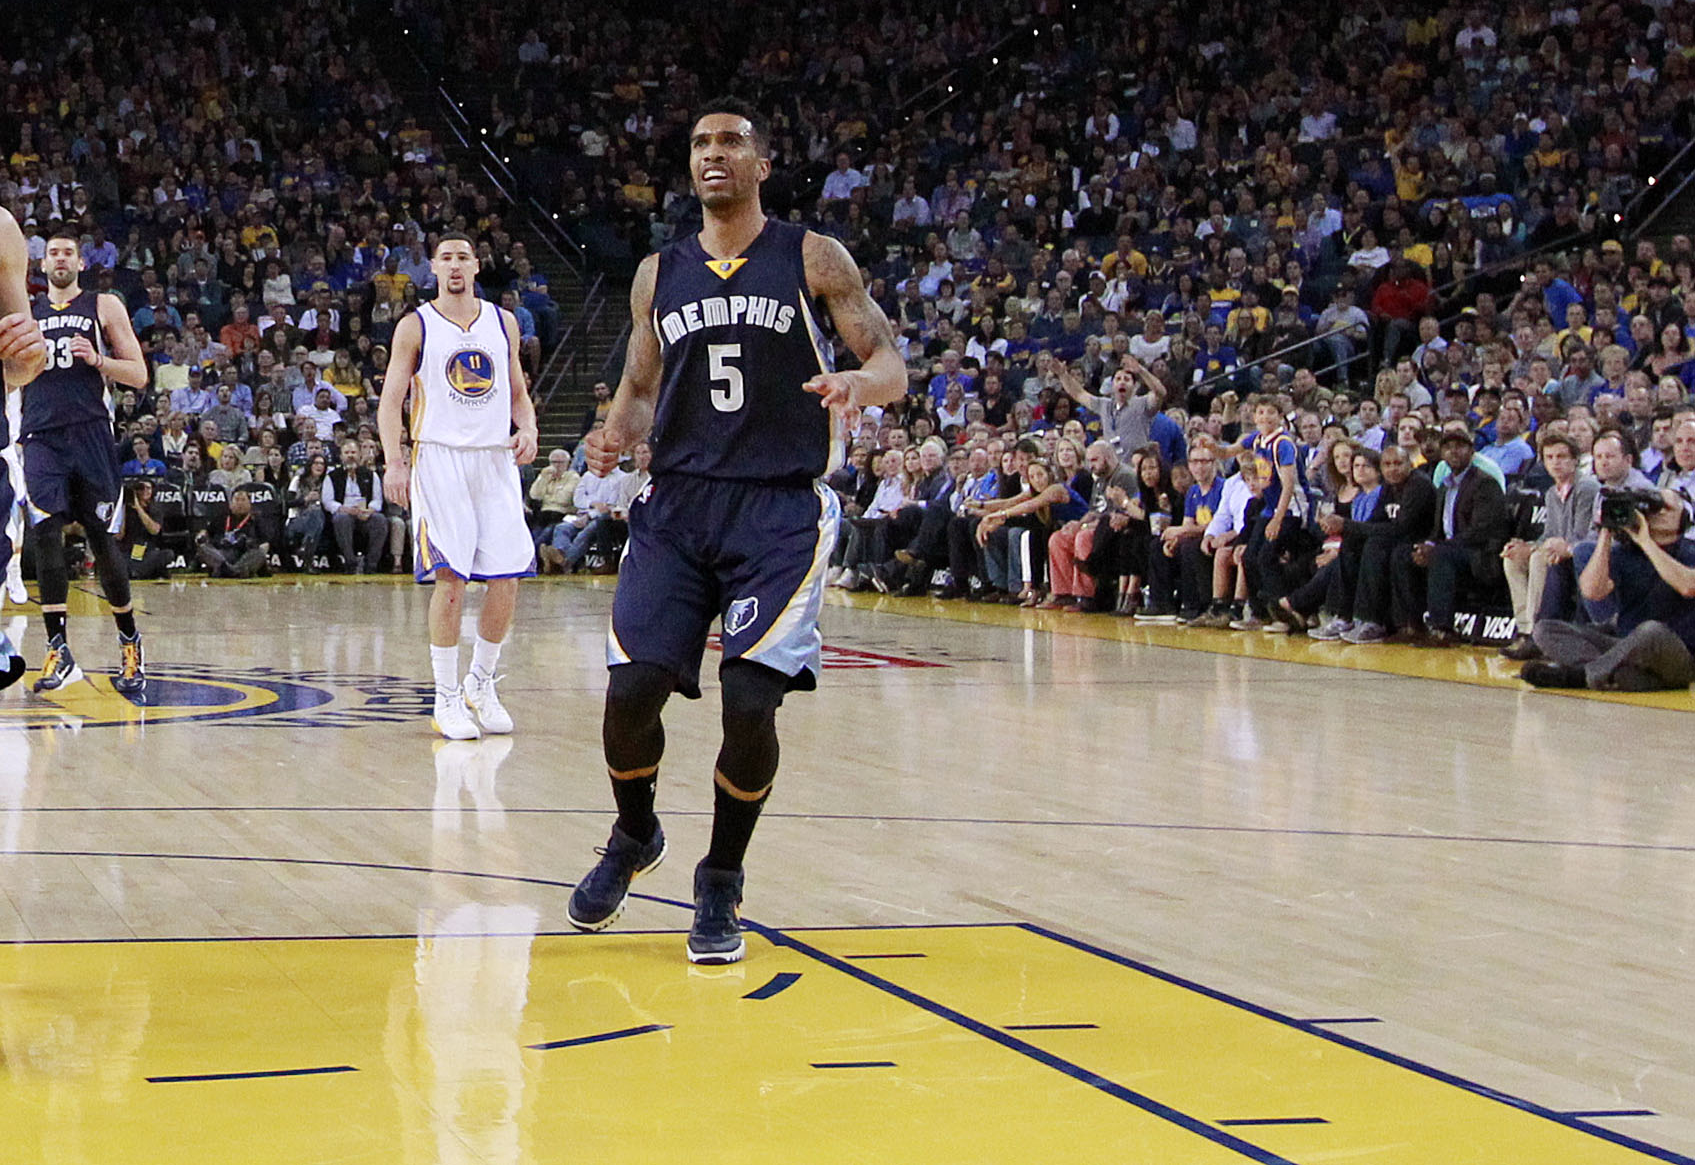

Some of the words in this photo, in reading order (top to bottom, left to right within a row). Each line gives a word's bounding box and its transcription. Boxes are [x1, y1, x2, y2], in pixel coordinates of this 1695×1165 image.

[38, 315, 92, 332] EMPHIS
[661, 295, 796, 345] MEMPHIS
[469, 354, 481, 370] 11
[707, 343, 745, 412] 5
[193, 490, 226, 503] VISA
[250, 490, 273, 503] ISA
[1482, 615, 1517, 639] VISA
